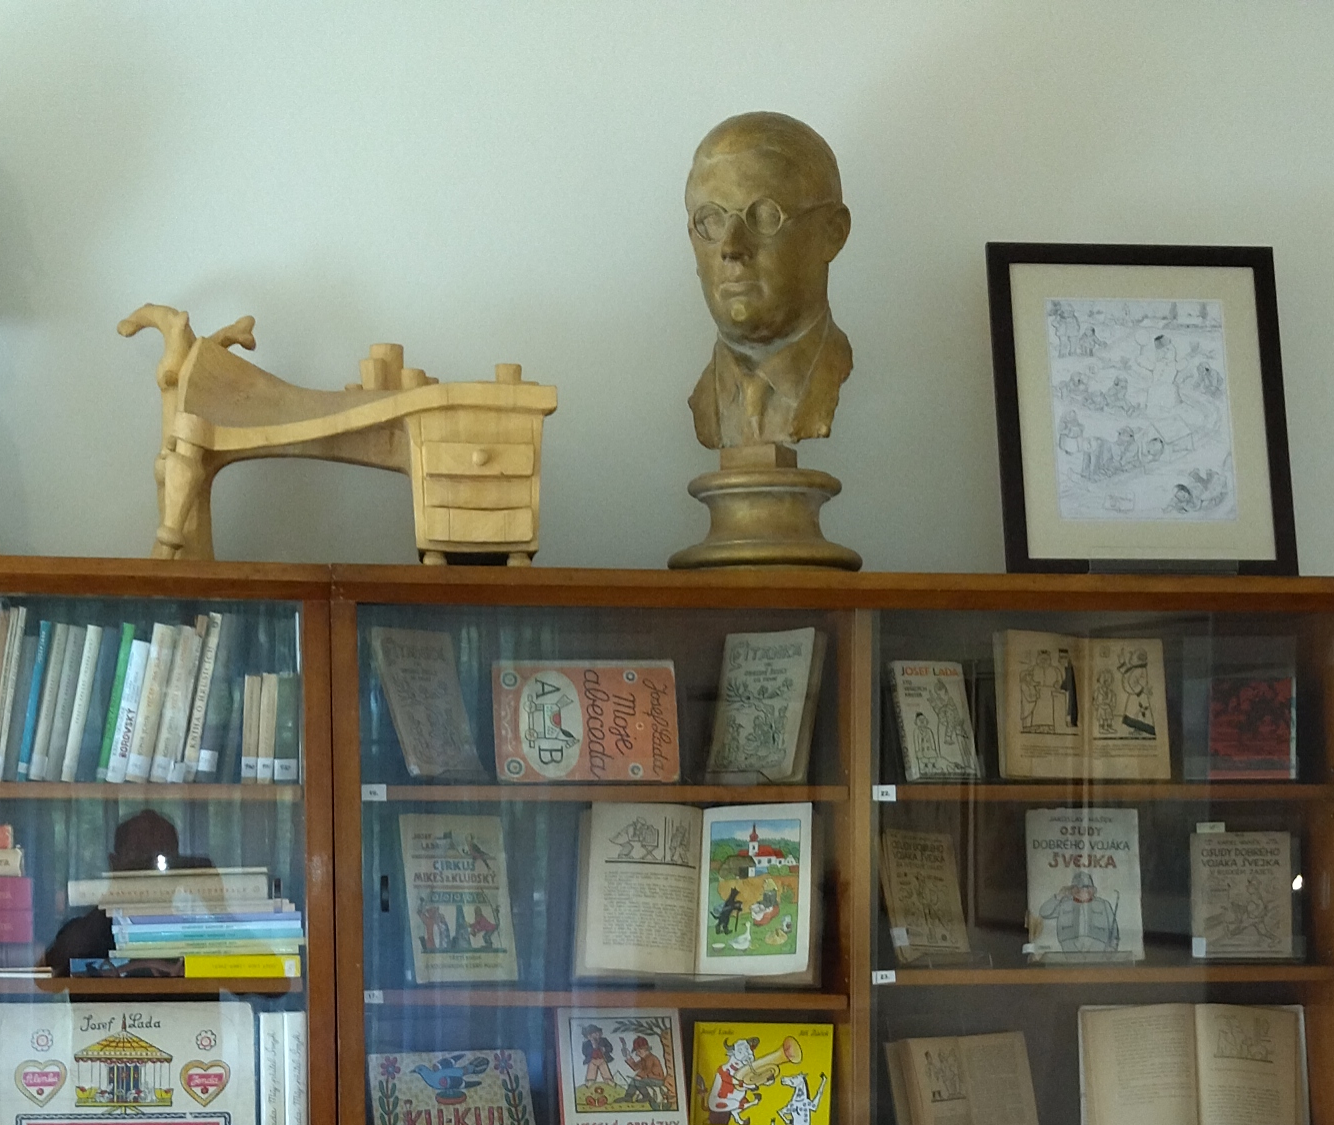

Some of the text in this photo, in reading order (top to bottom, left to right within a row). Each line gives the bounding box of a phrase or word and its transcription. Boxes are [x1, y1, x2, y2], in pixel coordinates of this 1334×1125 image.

[902, 667, 958, 677] JOSEF LADA
[535, 678, 561, 699] A
[189, 716, 201, 749] KNIHA
[583, 669, 614, 780] abeceda
[609, 693, 636, 756] Moje
[642, 678, 672, 776] Josef Lada
[119, 708, 136, 759] BOROVSKÝ
[538, 746, 563, 765] B
[1060, 826, 1102, 836] OSUDY
[1033, 838, 1131, 851] DOBRÉHO VOJÁKA
[1201, 847, 1281, 857] OSUDY DOBRÉHO
[433, 859, 476, 871] CIRKUS
[1048, 852, 1117, 869] ŠVEJKA
[1201, 857, 1281, 868] VOJÁKA ŠVEJKA
[413, 871, 497, 884] MIKEŠ KLUDSKÝ
[80, 1012, 161, 1032] Josef Lada
[189, 1075, 220, 1086] Jenda
